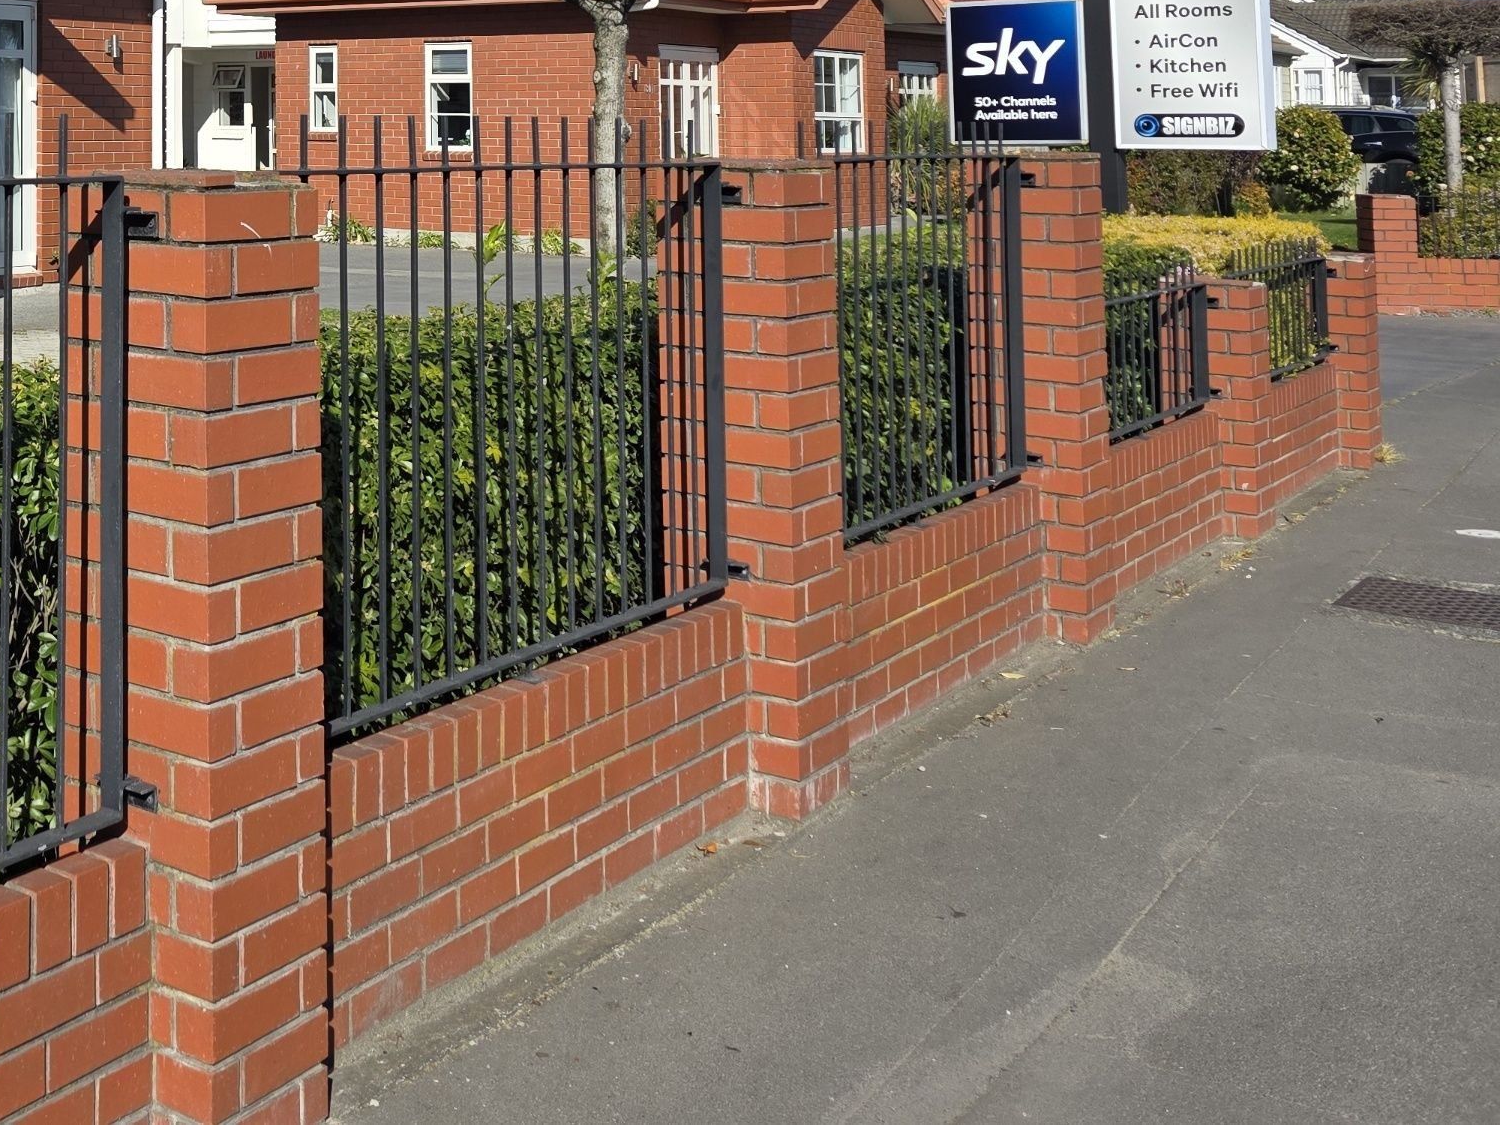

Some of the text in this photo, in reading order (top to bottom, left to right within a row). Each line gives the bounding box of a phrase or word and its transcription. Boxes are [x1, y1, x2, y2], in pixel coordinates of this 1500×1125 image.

[1134, 3, 1233, 20] All Rooms
[1149, 33, 1218, 50] AirCon
[962, 27, 1066, 85] sky
[1150, 59, 1227, 74] Kitchen
[1151, 82, 1239, 98] Free Wifi
[975, 94, 1057, 108] 50+ Channels
[975, 108, 1058, 122] Available here
[1162, 116, 1236, 136] SIGNBIZ
